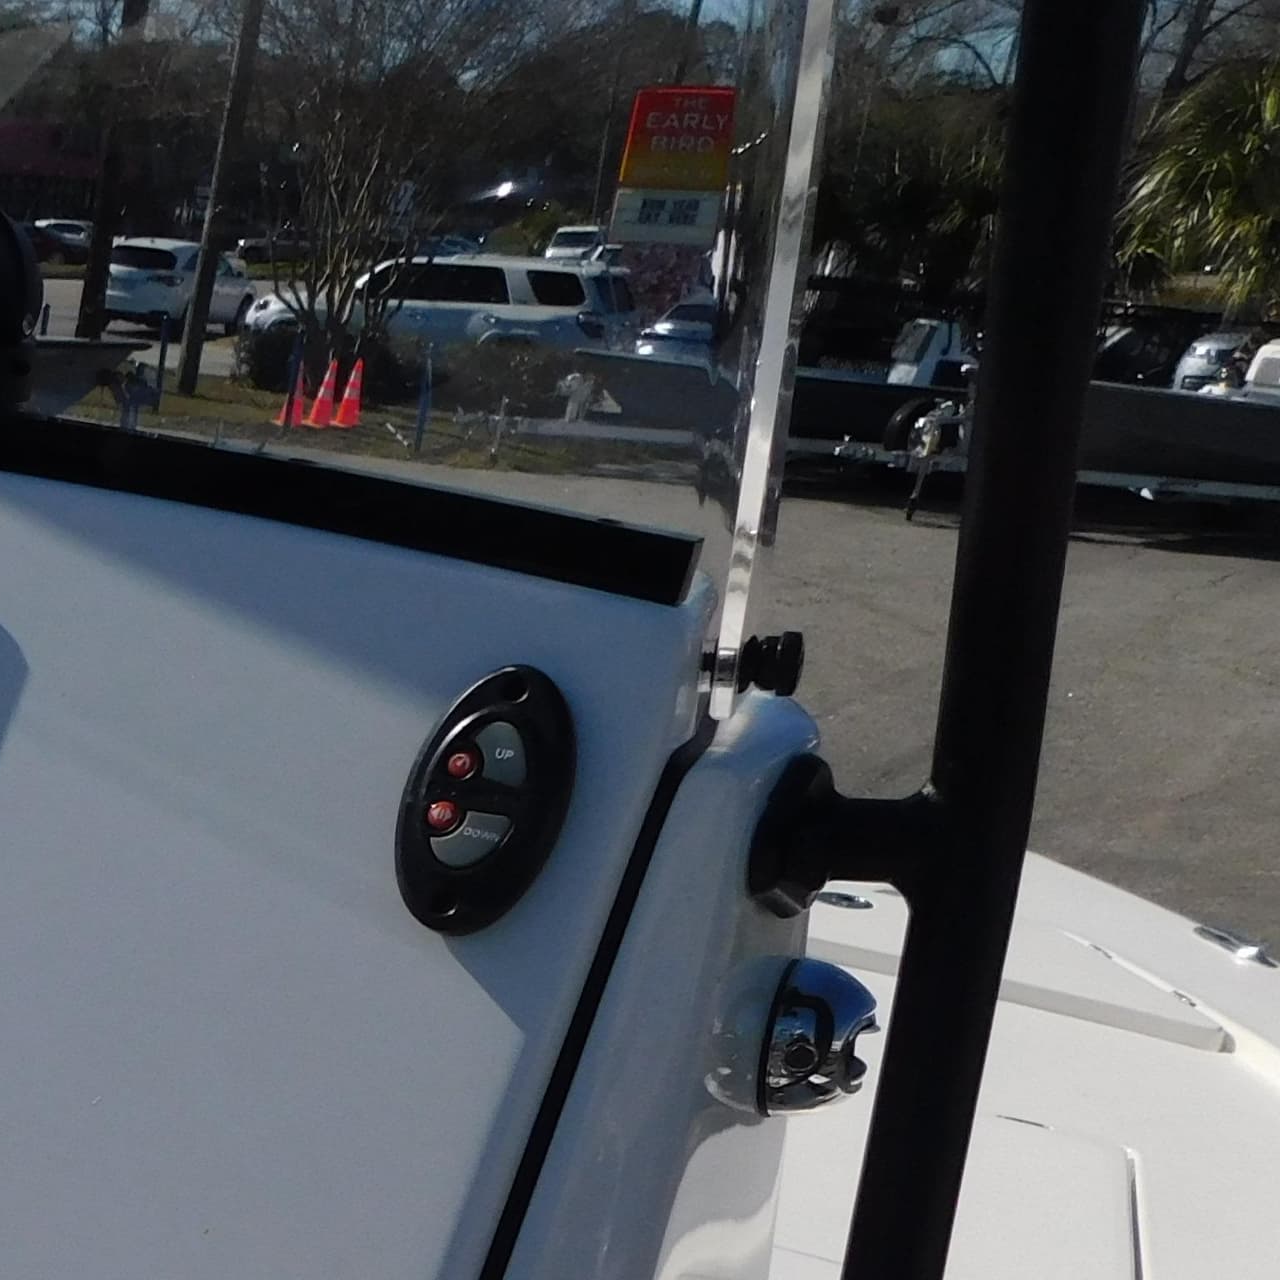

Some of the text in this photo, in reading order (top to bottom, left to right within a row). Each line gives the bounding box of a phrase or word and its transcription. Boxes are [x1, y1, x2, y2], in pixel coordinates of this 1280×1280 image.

[646, 111, 730, 130] EARLY
[650, 135, 715, 153] BIRD
[495, 747, 515, 760] UP
[463, 826, 501, 843] DOWN
